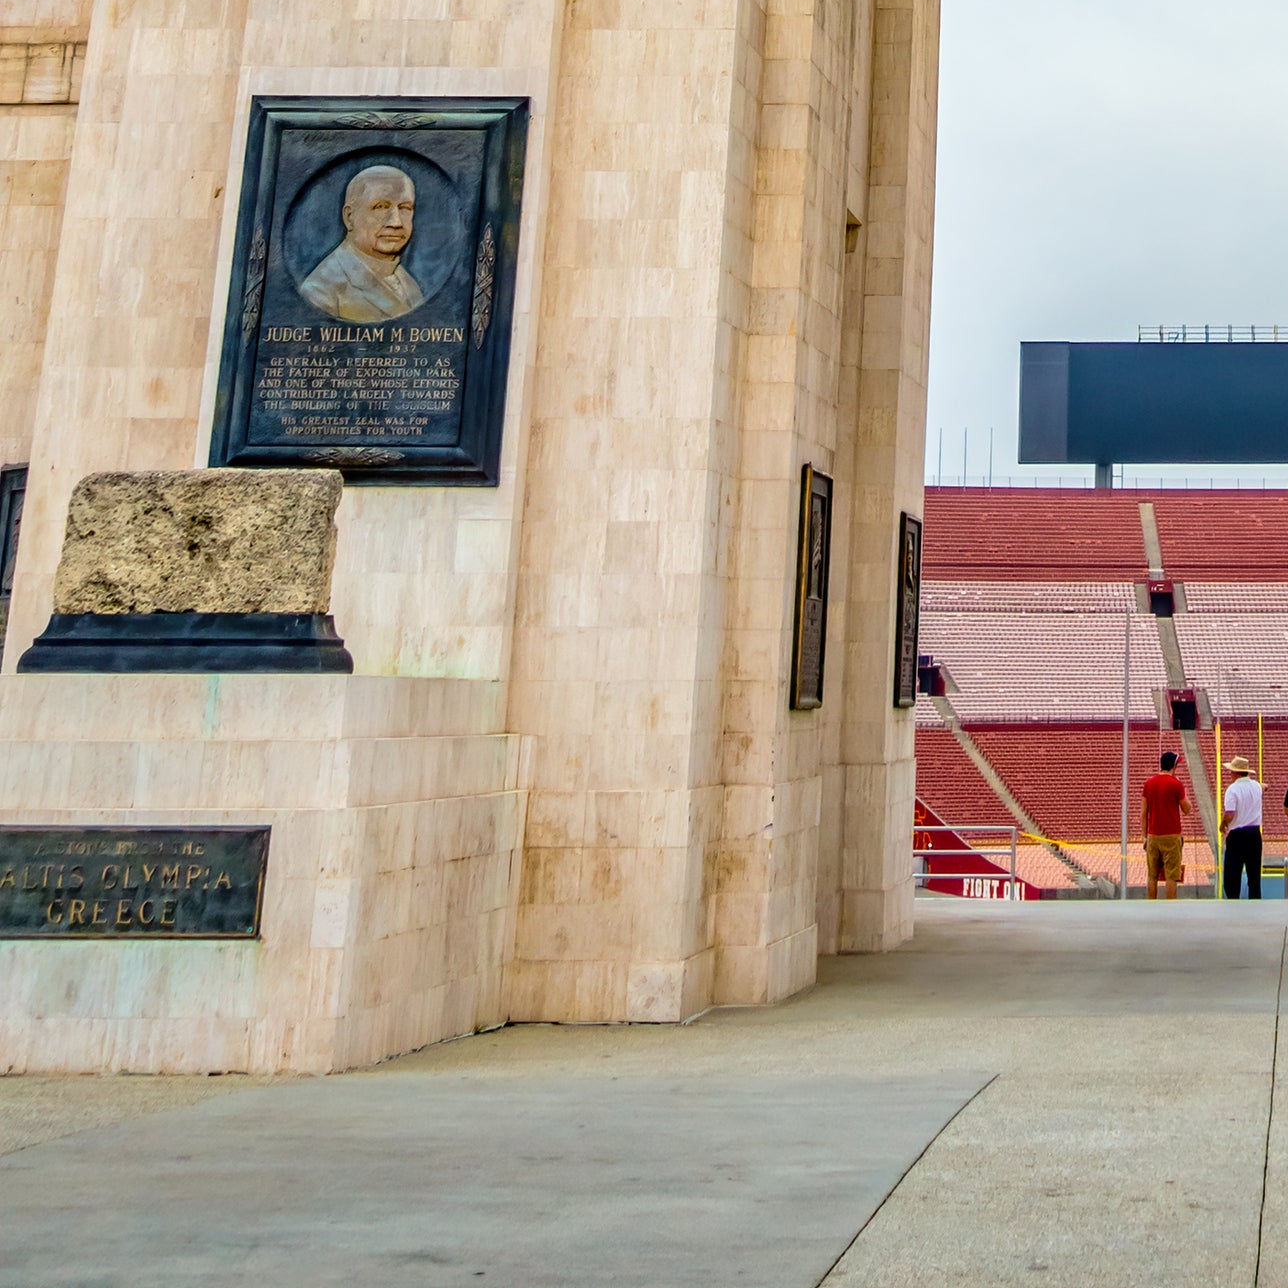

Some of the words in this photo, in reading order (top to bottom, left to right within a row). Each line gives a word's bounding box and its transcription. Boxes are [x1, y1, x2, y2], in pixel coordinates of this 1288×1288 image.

[262, 327, 312, 343] JUDGE
[320, 327, 384, 343] WILLIAM
[409, 327, 465, 343] BOWEN
[307, 344, 336, 353] 1862
[388, 344, 417, 353] 1937
[270, 357, 340, 367] GENERALLY
[346, 357, 407, 367] REFERRED
[413, 357, 428, 367] TO
[434, 357, 451, 367] AS
[263, 367, 284, 378] THE
[288, 367, 331, 378] FATHER
[335, 367, 350, 378] OF
[355, 367, 422, 378] EXPOSITION
[426, 367, 457, 378] PARK
[258, 378, 282, 389] AND
[285, 378, 308, 389] ONE
[311, 378, 325, 389] OF
[330, 378, 366, 389] THOSE
[370, 378, 408, 389] WHOSE
[412, 378, 460, 389] EFFORTS
[259, 389, 338, 399] CONTRIBUTED
[343, 389, 395, 399] LARGELY
[401, 389, 456, 399] TOWARDS
[263, 400, 286, 410] THE
[290, 400, 341, 410] BUILDING
[346, 400, 360, 410] OF
[368, 400, 390, 410] THE
[281, 417, 297, 425] HIS
[301, 417, 350, 425] GREATEST
[355, 417, 380, 425] ZEAL
[384, 417, 405, 425] WAS
[409, 417, 428, 425] FOR
[285, 426, 362, 435] OPPORTUNITIES
[366, 426, 385, 435] FOR
[390, 426, 423, 435] YOUTH
[0, 864, 85, 890] ALTIS
[101, 864, 233, 890] OLYMPIA
[963, 878, 1000, 899] FIGHT
[46, 899, 179, 924] GREECE
